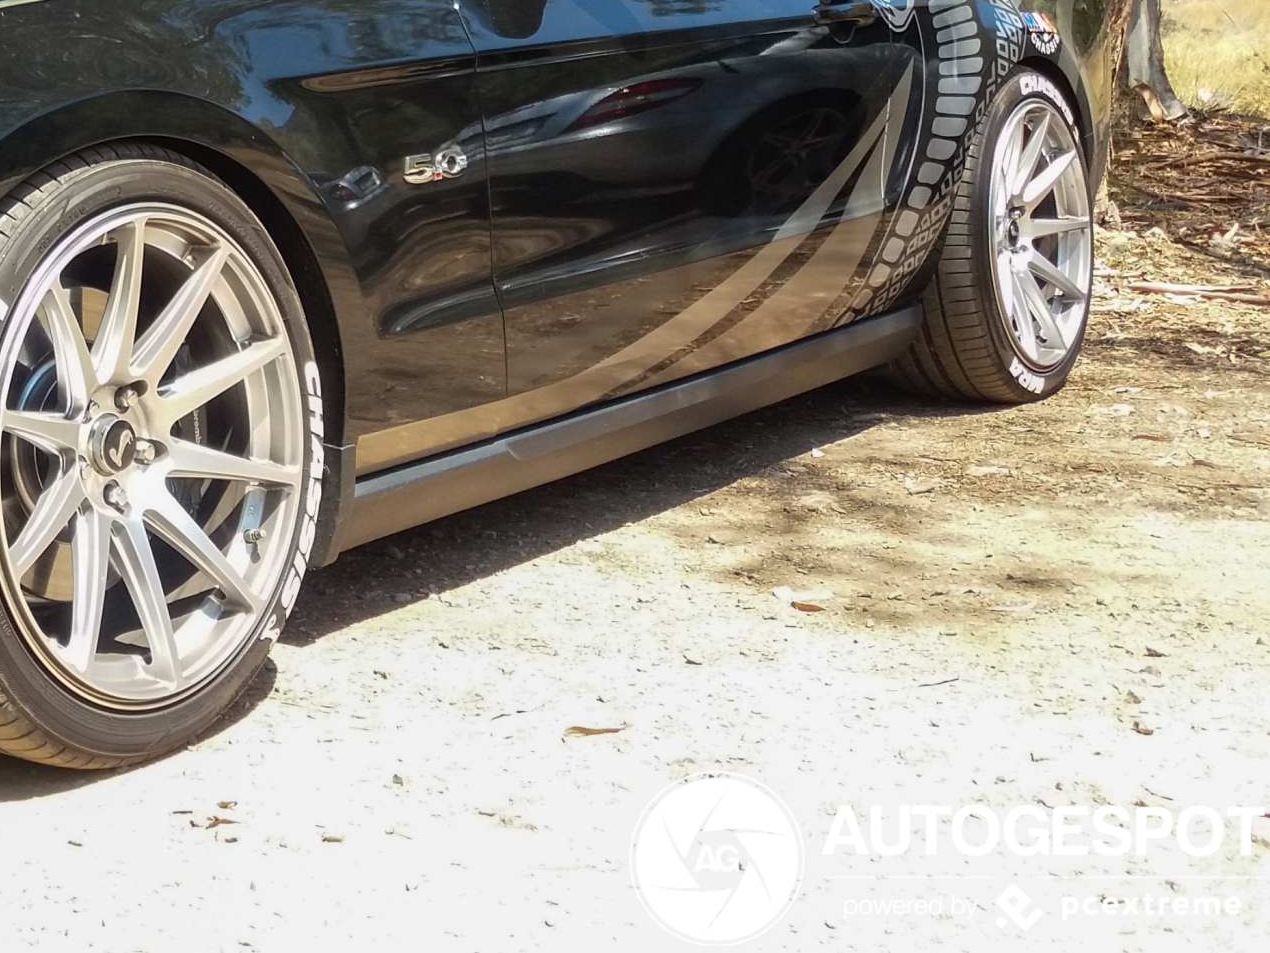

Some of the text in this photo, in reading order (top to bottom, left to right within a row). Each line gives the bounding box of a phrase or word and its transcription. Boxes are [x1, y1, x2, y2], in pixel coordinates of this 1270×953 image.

[1031, 33, 1060, 55] CHASSIS
[404, 147, 468, 184] 5.0
[1009, 356, 1045, 394] MRA
[193, 409, 202, 445] bremb
[281, 361, 325, 619] CHASSIS
